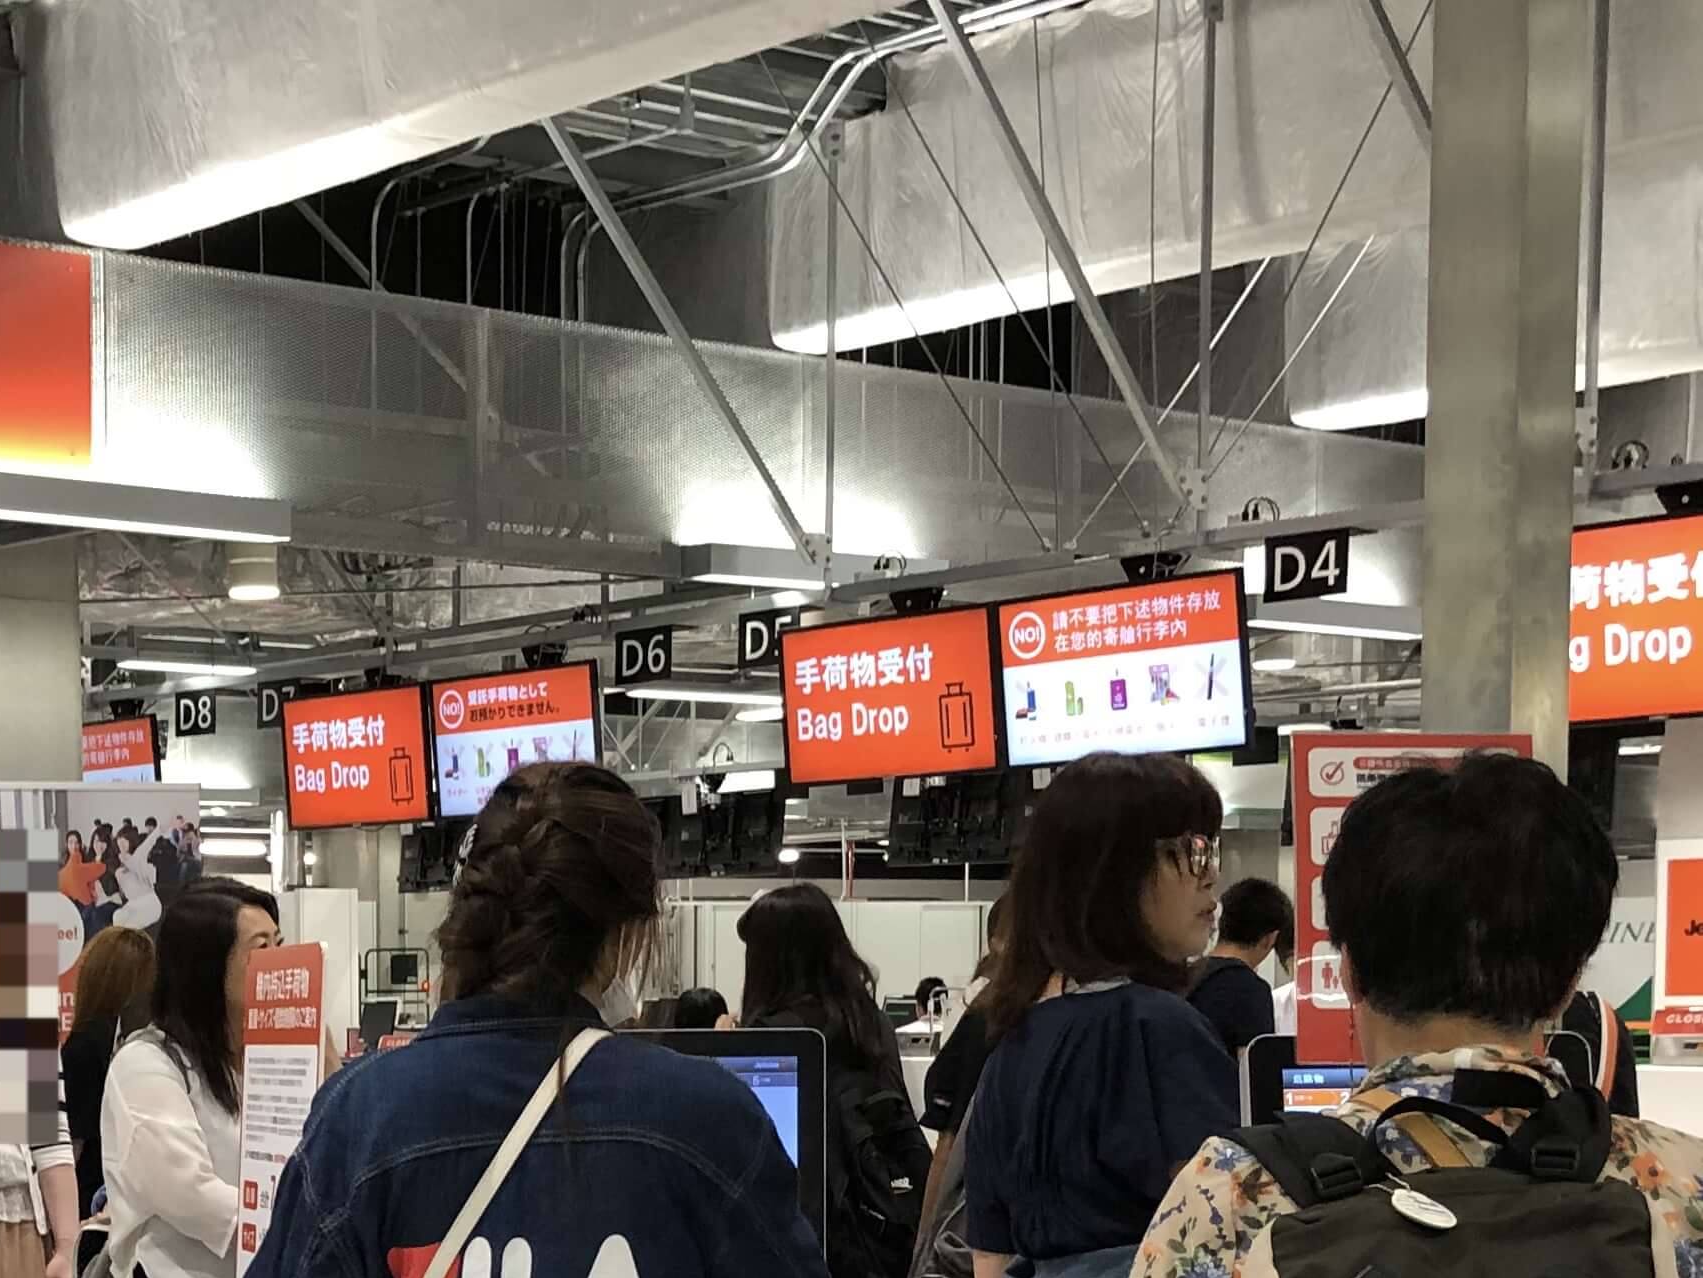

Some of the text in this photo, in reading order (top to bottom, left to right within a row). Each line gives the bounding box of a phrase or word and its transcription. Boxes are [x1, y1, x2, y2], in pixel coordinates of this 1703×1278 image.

[1274, 539, 1340, 592] D4
[1014, 626, 1041, 644] NO!
[1604, 623, 1692, 666] Drop
[622, 634, 665, 677] D6
[795, 643, 933, 694] 手荷物受付
[179, 696, 212, 731] D8
[292, 714, 385, 753] 手荷物受付
[797, 702, 909, 742] Bag Drop
[294, 761, 370, 794] Bag Drop
